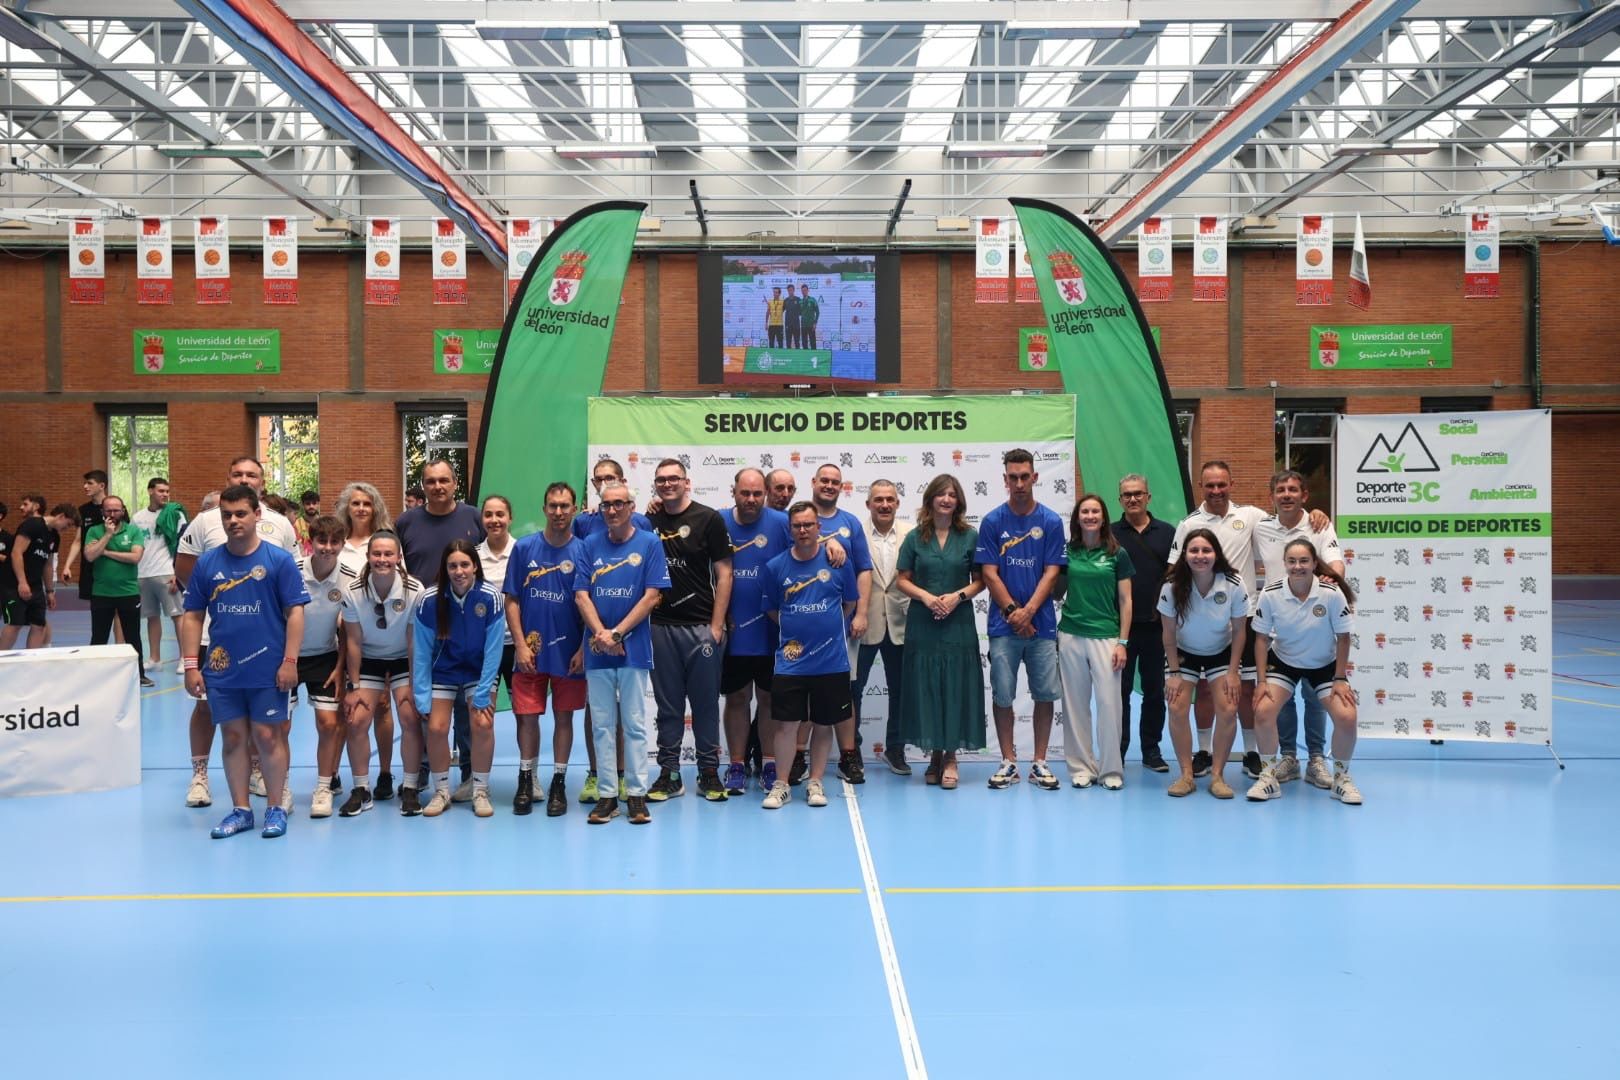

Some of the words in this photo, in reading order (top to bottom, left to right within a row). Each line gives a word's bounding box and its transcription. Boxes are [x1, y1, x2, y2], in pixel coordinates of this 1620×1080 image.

[527, 307, 610, 329] universidad
[534, 319, 563, 335] león
[1066, 321, 1094, 335] león
[176, 336, 231, 345] Universidad
[234, 336, 245, 345] de
[248, 336, 270, 345] León
[1352, 332, 1404, 340] Universidad
[1408, 332, 1418, 340] de
[1422, 332, 1443, 340] León
[178, 354, 208, 364] Servicio
[210, 353, 218, 361] de
[222, 352, 253, 362] Deportes
[1358, 351, 1387, 360] Servicio
[1389, 349, 1398, 357] de
[1400, 348, 1430, 358] Deportes
[704, 412, 809, 433] SERVICIO
[816, 412, 844, 432] DE
[852, 410, 967, 431] DEPORTES
[1439, 424, 1477, 435] Social
[1452, 454, 1508, 466] Personal
[1356, 482, 1406, 496] Deporte
[1408, 481, 1440, 503] 3C
[1469, 488, 1537, 500] Ambiental
[1348, 520, 1422, 534] SERVICIO
[1428, 520, 1448, 533] DE
[1452, 518, 1542, 532] DEPORTES
[531, 588, 564, 601] Drasanvi
[596, 586, 632, 596] Drasanvi
[217, 600, 261, 612] Drasanvi
[791, 600, 827, 613] Drasanvi
[0, 704, 80, 731] sidad
